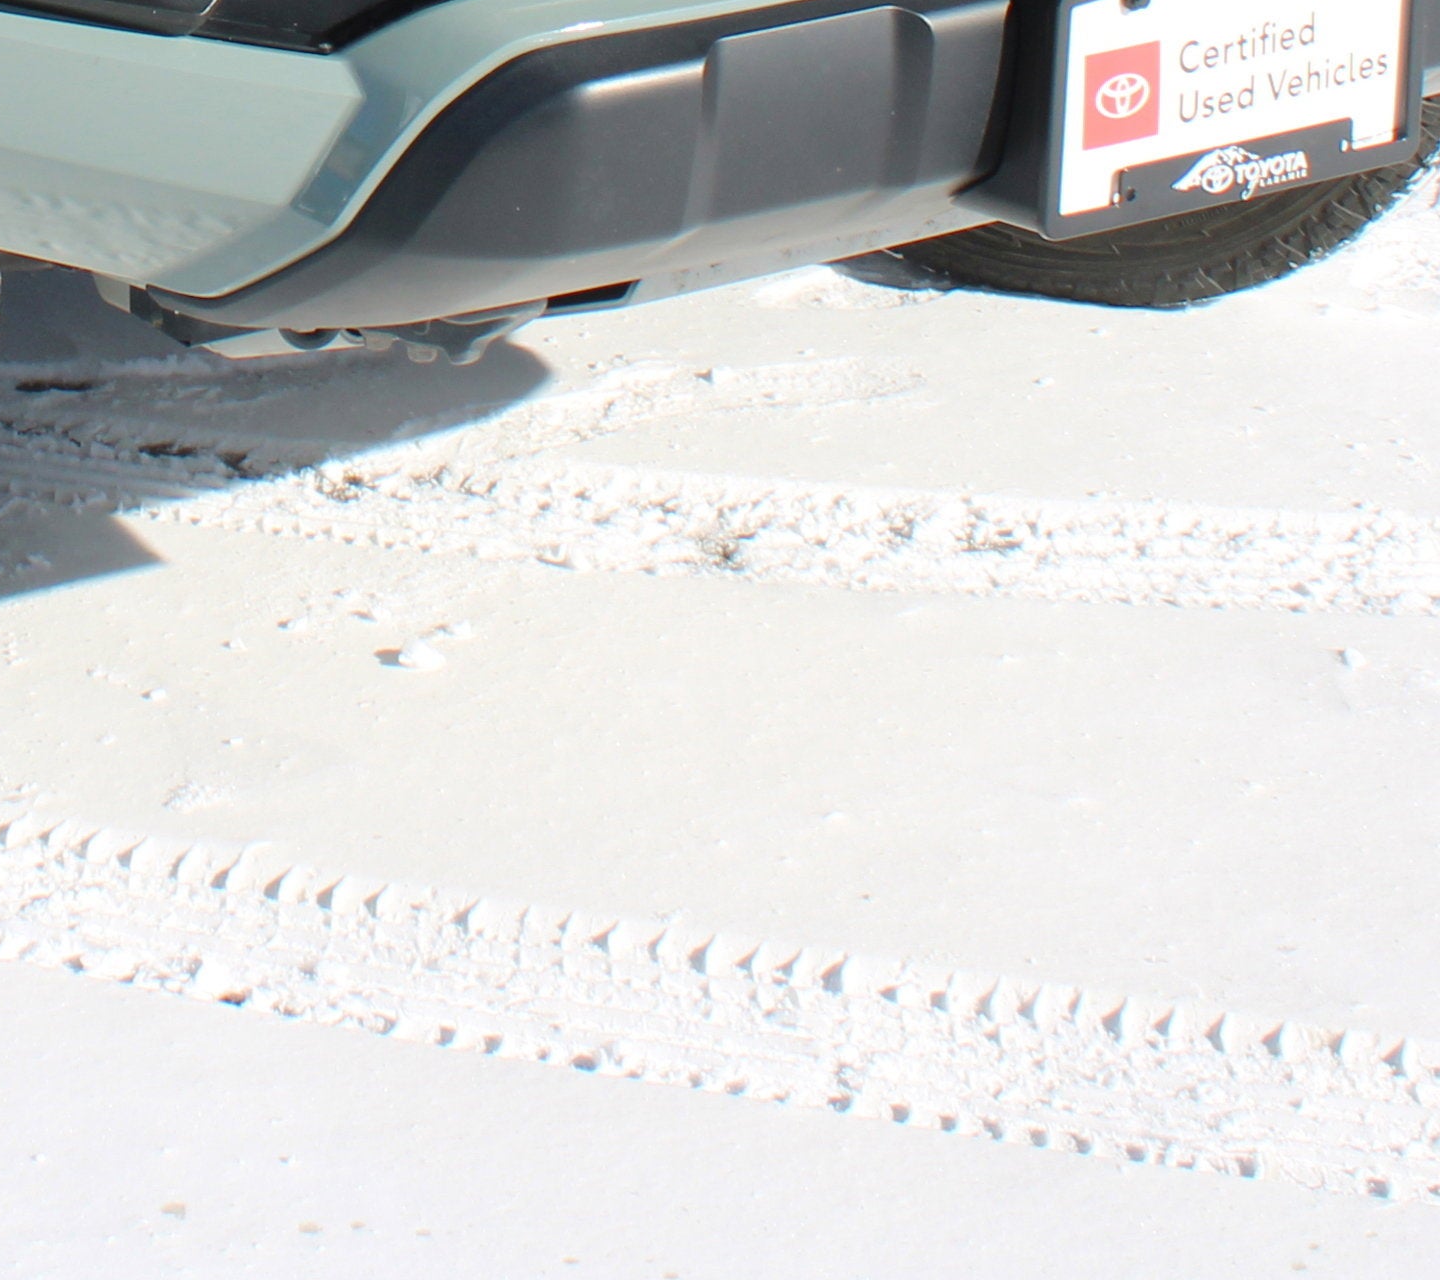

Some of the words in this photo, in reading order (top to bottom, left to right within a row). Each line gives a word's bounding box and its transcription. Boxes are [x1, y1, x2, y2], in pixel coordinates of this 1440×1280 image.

[1178, 11, 1316, 74] Certified
[1178, 74, 1256, 124] Used
[1267, 52, 1389, 102] Vehicles
[1233, 150, 1309, 186] TOYOTA
[1259, 169, 1308, 188] LARAMIE
